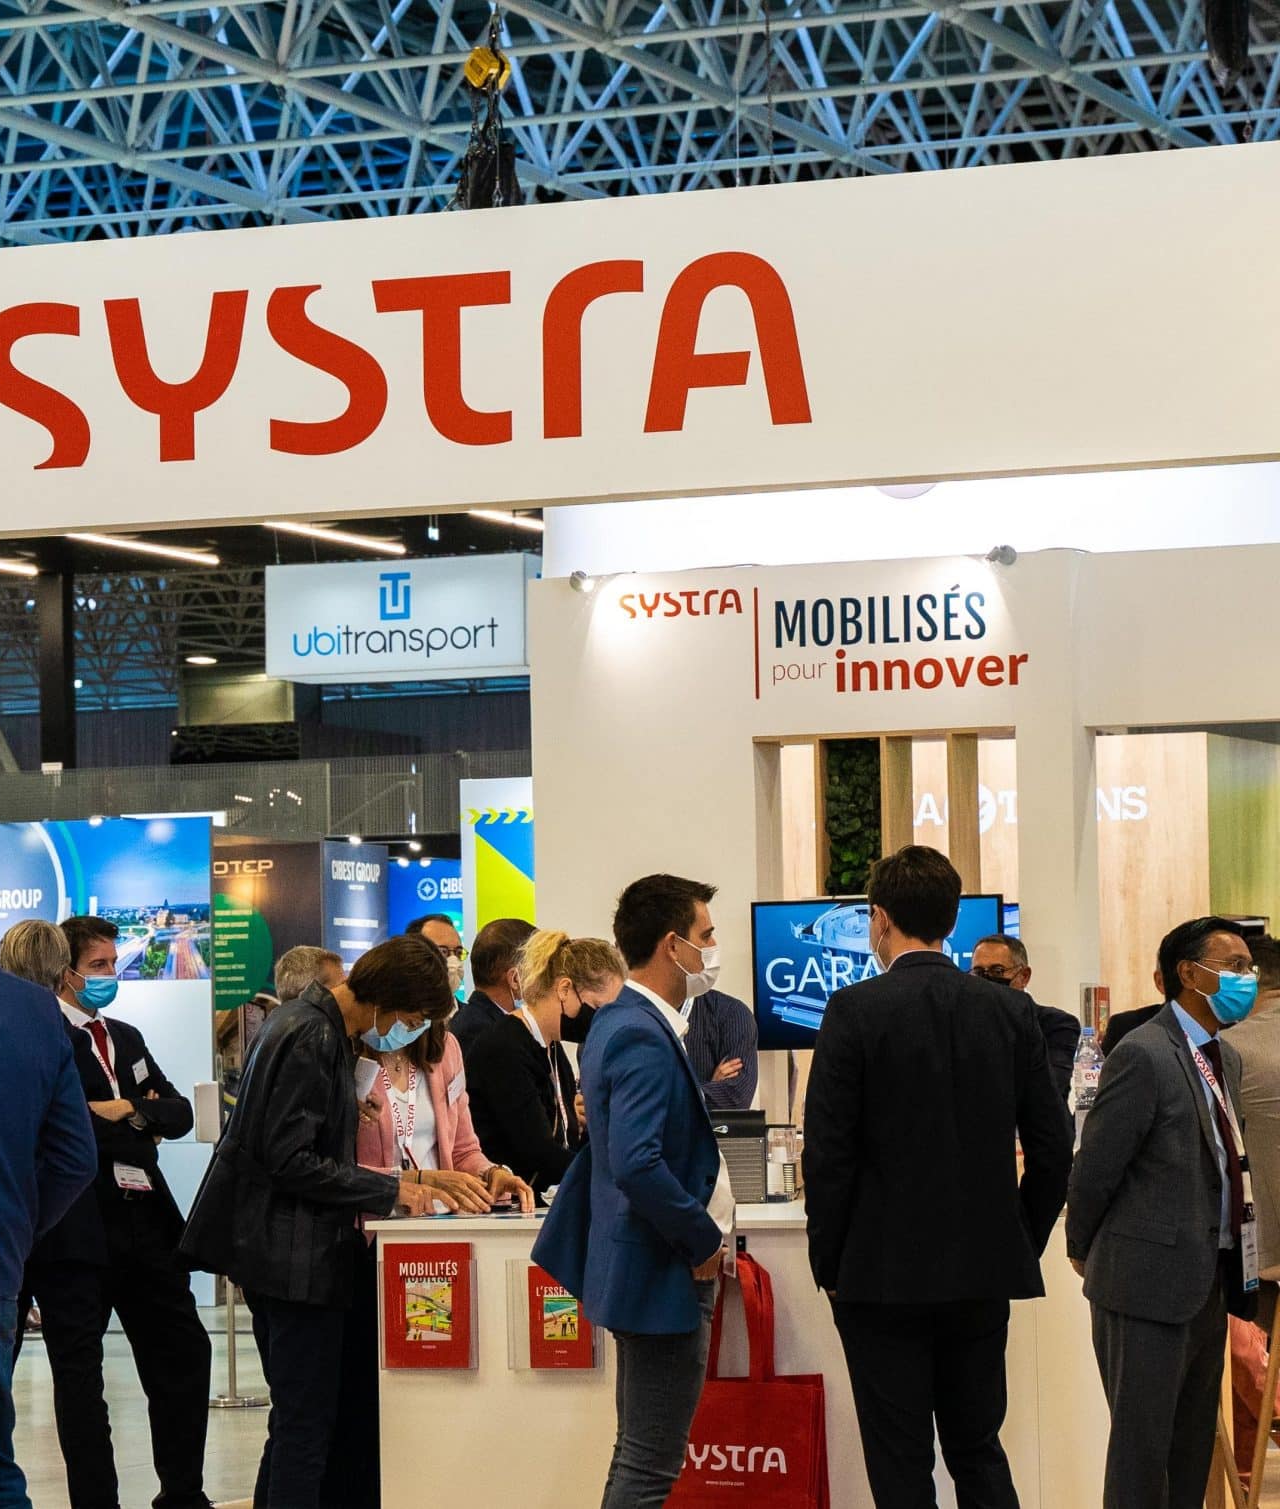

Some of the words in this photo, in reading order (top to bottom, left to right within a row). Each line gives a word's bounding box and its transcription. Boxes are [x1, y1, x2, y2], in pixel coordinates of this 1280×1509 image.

[620, 589, 743, 619] SYSTRA
[774, 584, 986, 648] MOBILISÉS
[293, 617, 498, 658] ubitransport
[773, 659, 828, 686] pour
[836, 649, 1029, 692] innover
[213, 860, 273, 874] OTEP
[331, 860, 355, 881] CIBEST
[356, 861, 380, 883] GROUP
[440, 877, 463, 893] CIBE
[409, 1063, 417, 1091] SYSTR
[1194, 1051, 1216, 1086] SYSTRA
[406, 1104, 416, 1137] SYSTRA
[399, 1259, 458, 1277] MOBILITÉS
[681, 1443, 788, 1474] YSTRA
